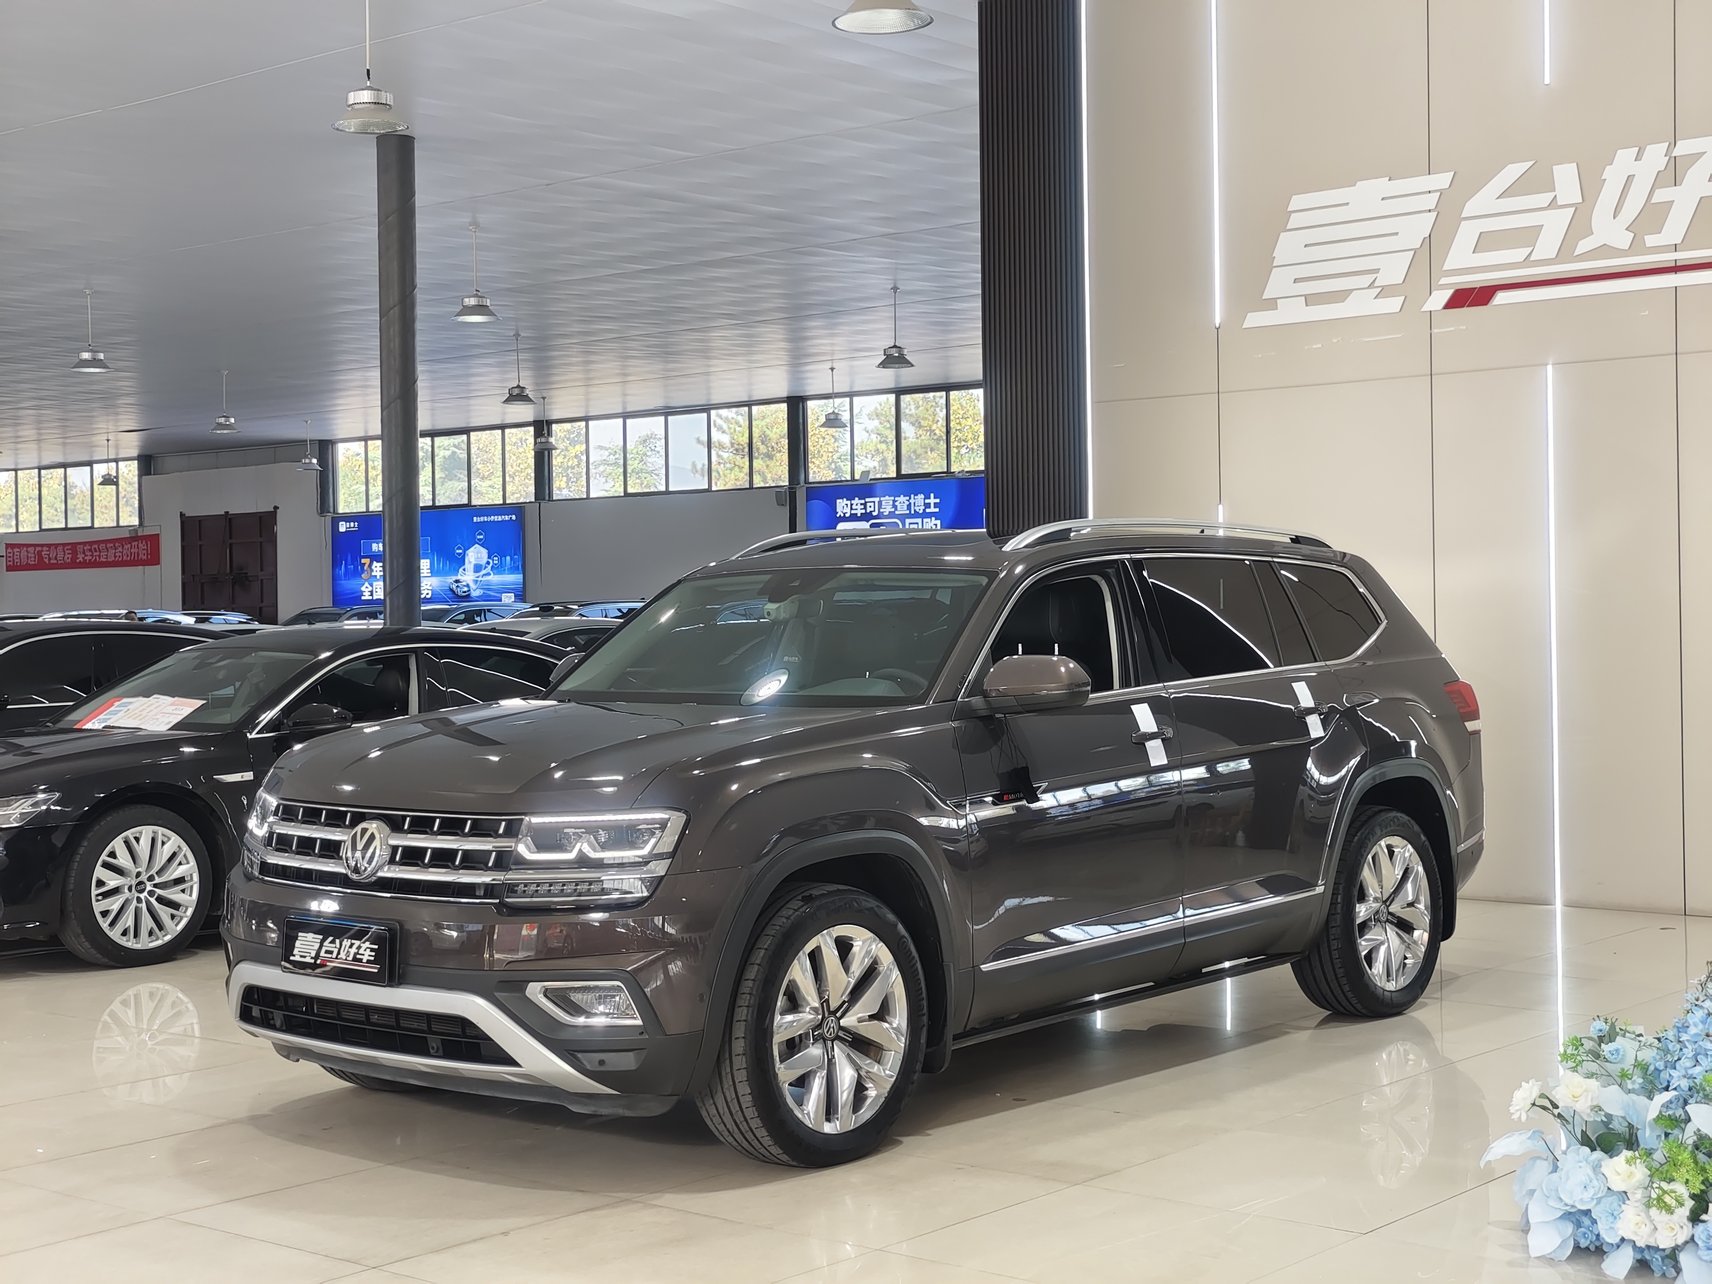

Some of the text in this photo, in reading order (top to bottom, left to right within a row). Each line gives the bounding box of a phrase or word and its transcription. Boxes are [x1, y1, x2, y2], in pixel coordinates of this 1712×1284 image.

[1242, 136, 1712, 328] 壹台好
[836, 493, 940, 517] 购车可享查博士
[361, 558, 383, 580] 3年
[360, 582, 384, 600] 全国
[289, 931, 379, 963] 壹台好车
